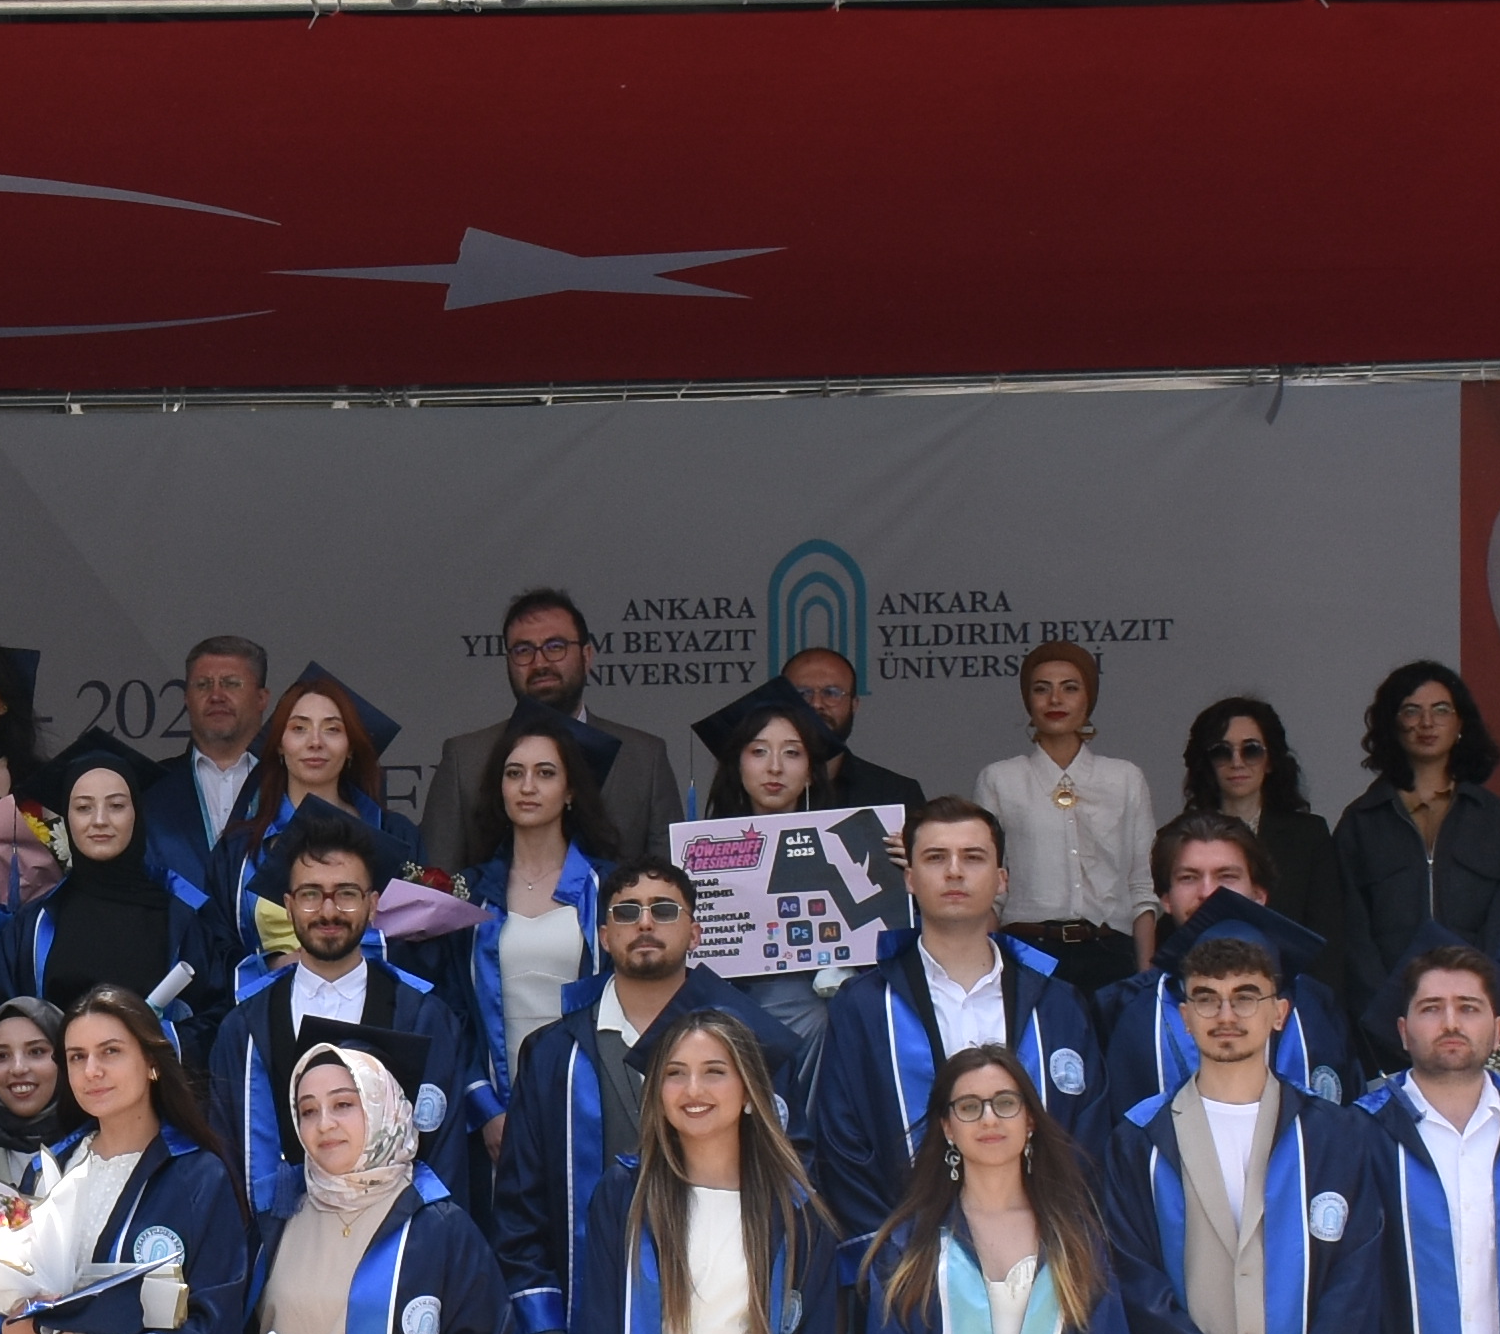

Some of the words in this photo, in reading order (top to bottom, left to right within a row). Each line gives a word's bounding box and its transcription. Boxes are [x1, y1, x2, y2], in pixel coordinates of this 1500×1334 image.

[622, 596, 756, 621] ANKARA
[876, 590, 1012, 616] ANKARA
[623, 629, 757, 654] BEYAZIT
[877, 622, 1031, 648] YILDIRIM
[1040, 618, 1174, 645] BEYAZIT
[585, 660, 756, 687] NIVERSITY
[76, 679, 193, 740] 202
[686, 839, 764, 858] POWERPUFF
[786, 847, 815, 858] 2025
[694, 854, 759, 871] DESIGNERS
[780, 900, 797, 913] Ae
[791, 927, 809, 940] Ps
[823, 925, 837, 938] Ai
